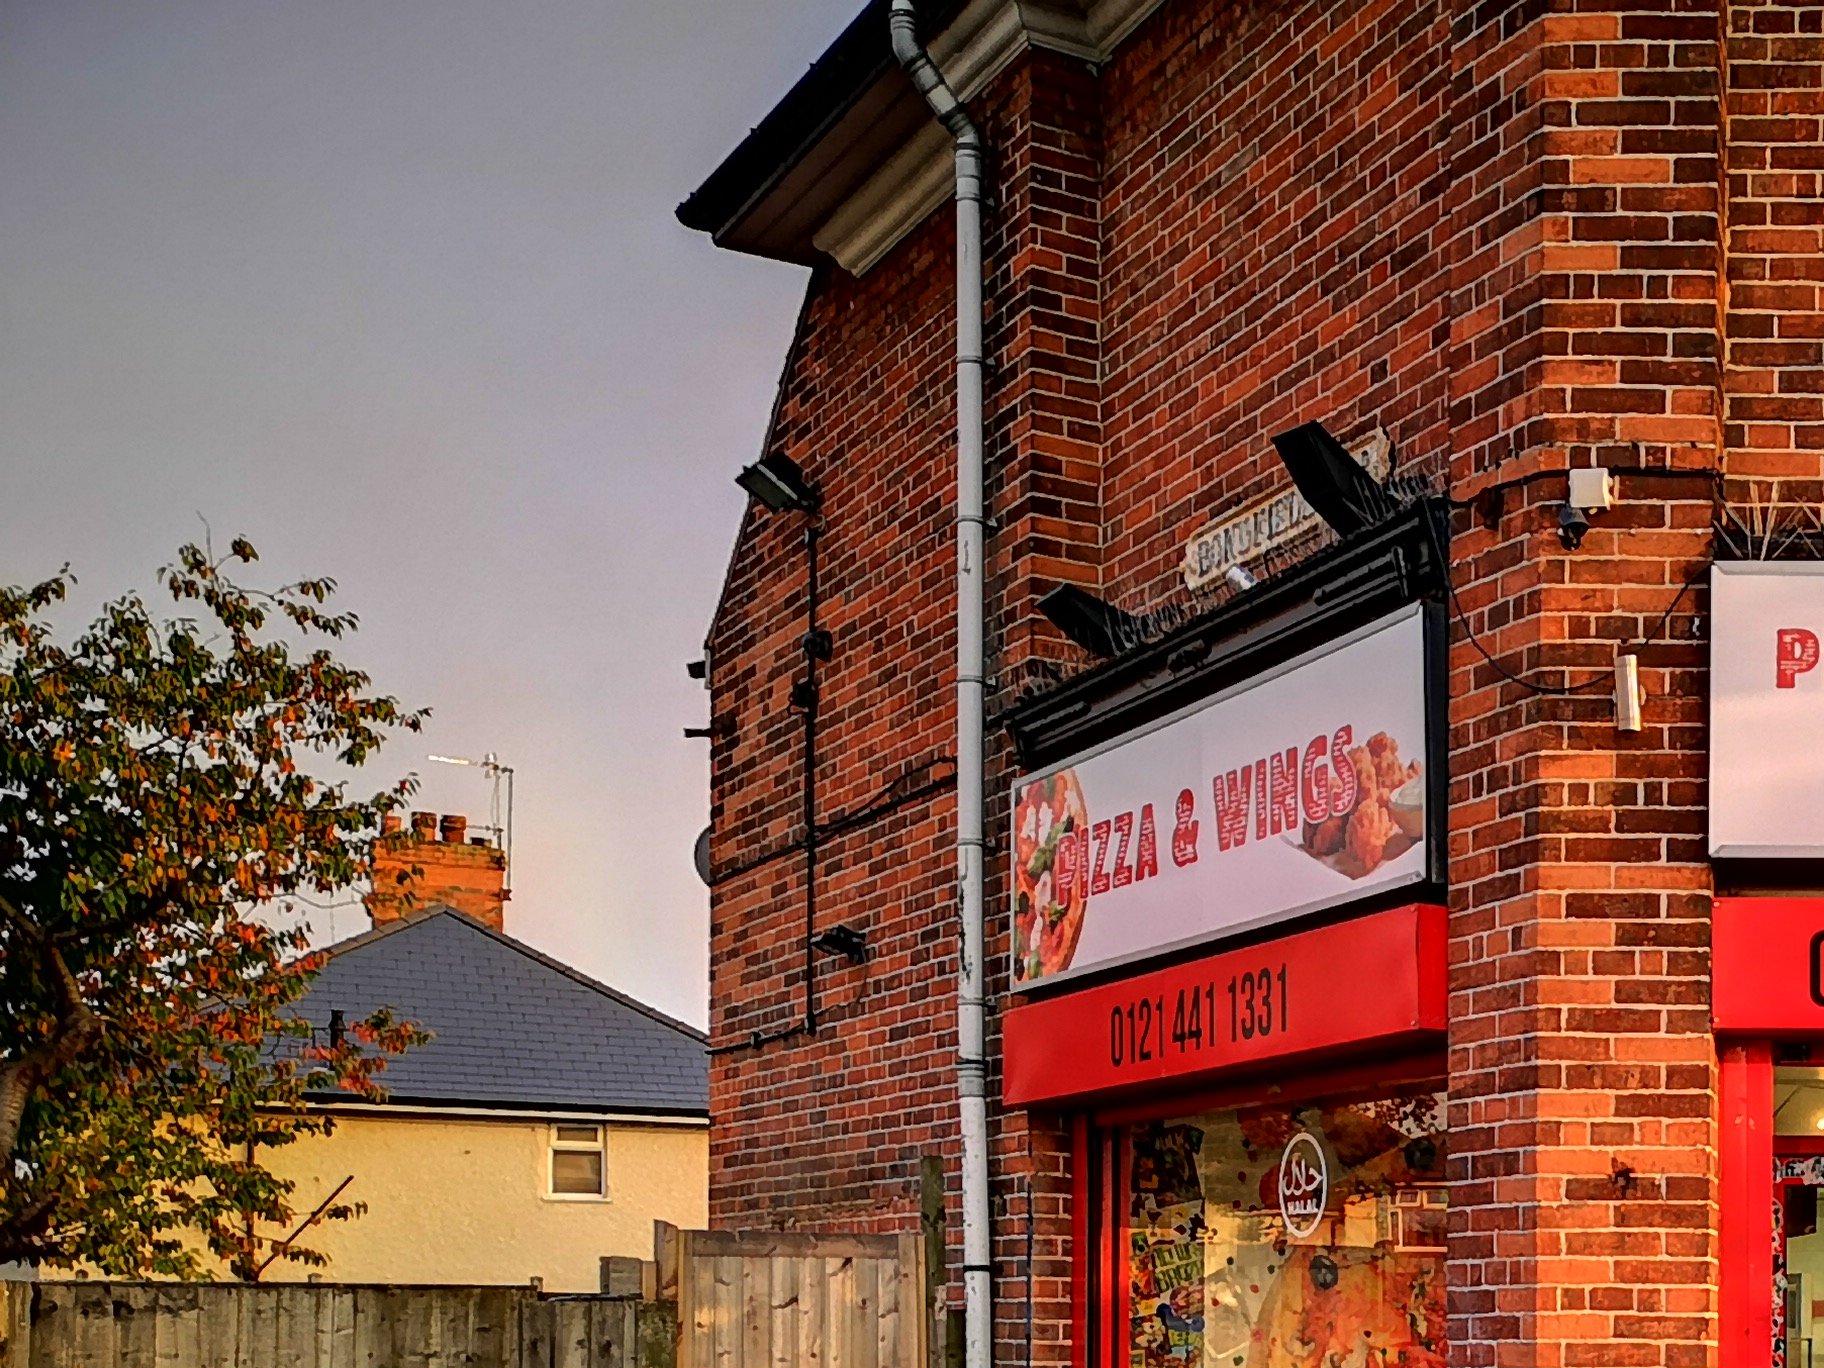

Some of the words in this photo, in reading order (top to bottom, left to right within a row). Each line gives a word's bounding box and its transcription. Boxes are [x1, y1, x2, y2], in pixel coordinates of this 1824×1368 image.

[1058, 803, 1158, 909] PIZZA
[1172, 788, 1199, 868] &
[1213, 724, 1358, 852] WINGS
[1111, 995, 1164, 1067] 0121
[1172, 982, 1215, 1053] 441
[1228, 963, 1287, 1042] 1331
